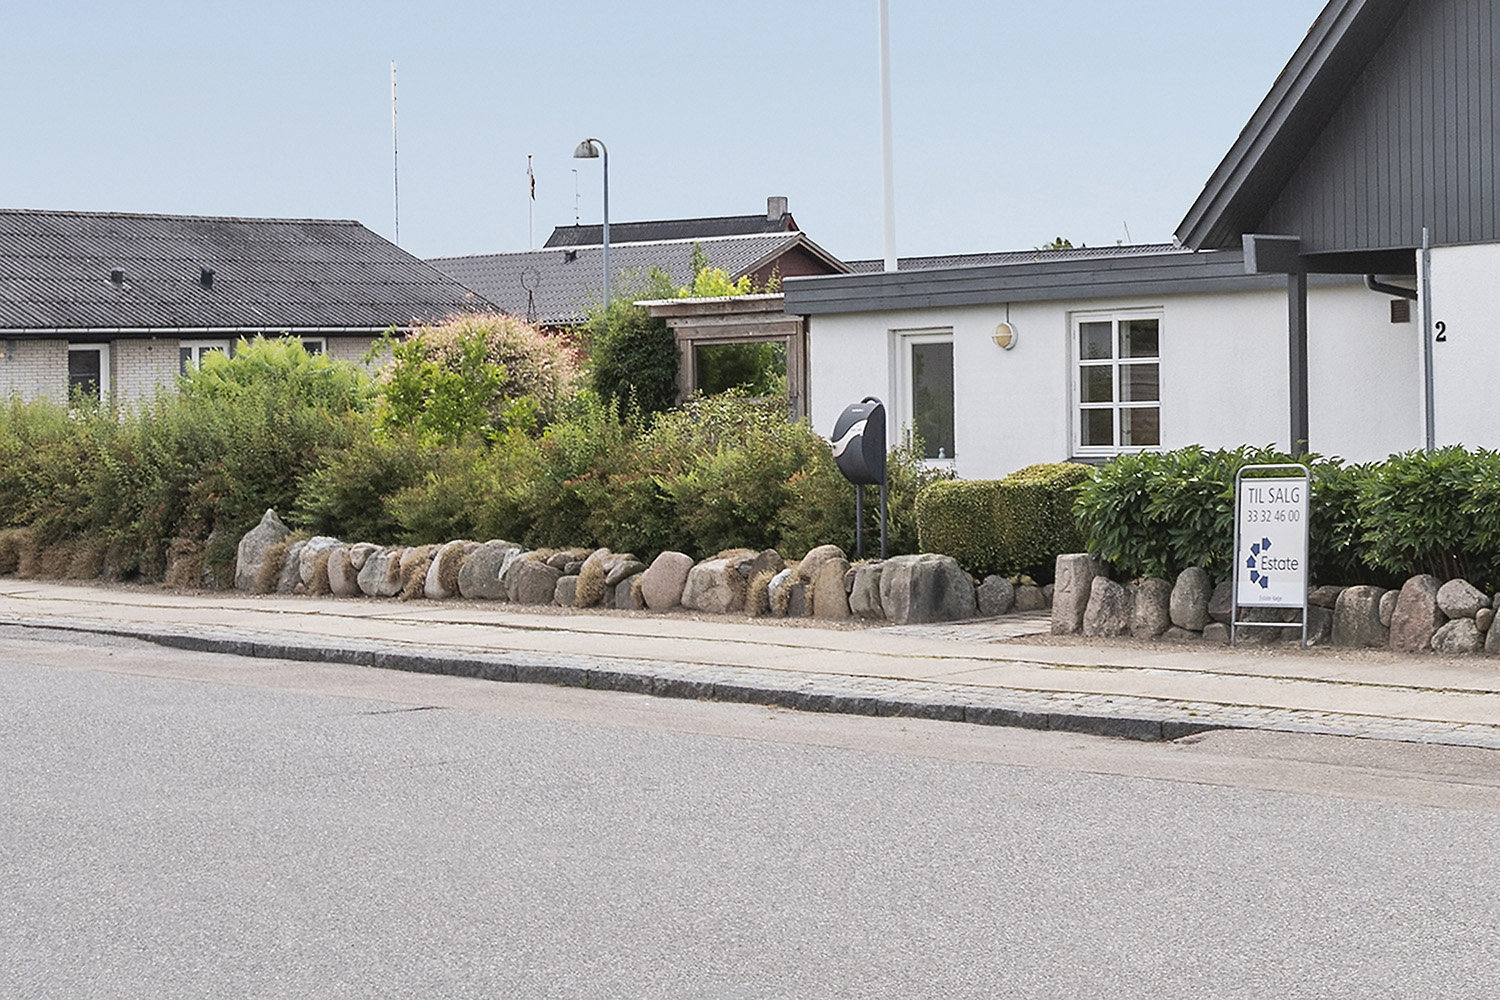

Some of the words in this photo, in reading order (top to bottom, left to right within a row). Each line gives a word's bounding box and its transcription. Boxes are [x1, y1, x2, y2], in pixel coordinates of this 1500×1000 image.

[1435, 321, 1447, 342] 2
[1248, 488, 1264, 503] TIL
[1268, 487, 1300, 503] SALG
[1247, 510, 1258, 522] 33
[1260, 510, 1271, 522] 32
[1274, 510, 1286, 522] 46
[1288, 510, 1300, 522] 00
[1261, 555, 1299, 571] Estate
